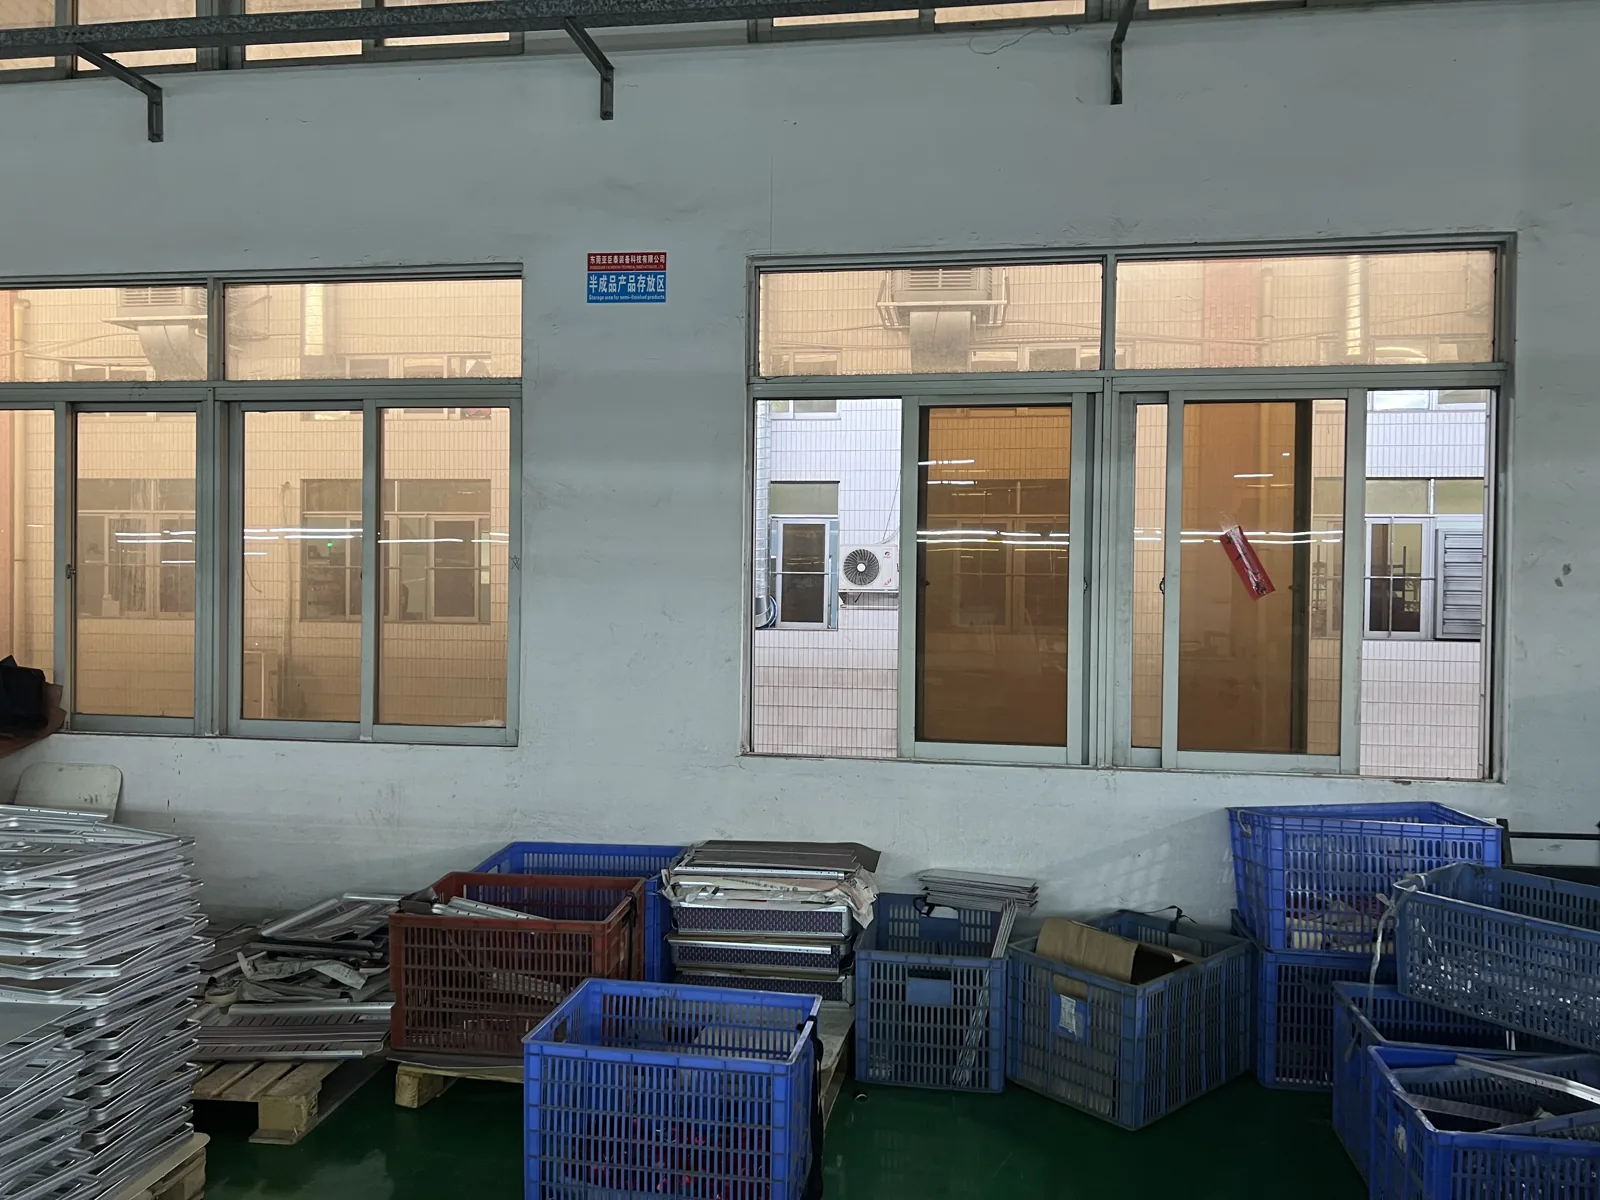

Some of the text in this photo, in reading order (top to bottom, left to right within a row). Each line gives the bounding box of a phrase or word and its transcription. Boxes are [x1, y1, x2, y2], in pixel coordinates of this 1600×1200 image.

[589, 274, 665, 293] 半成品产品存放区
